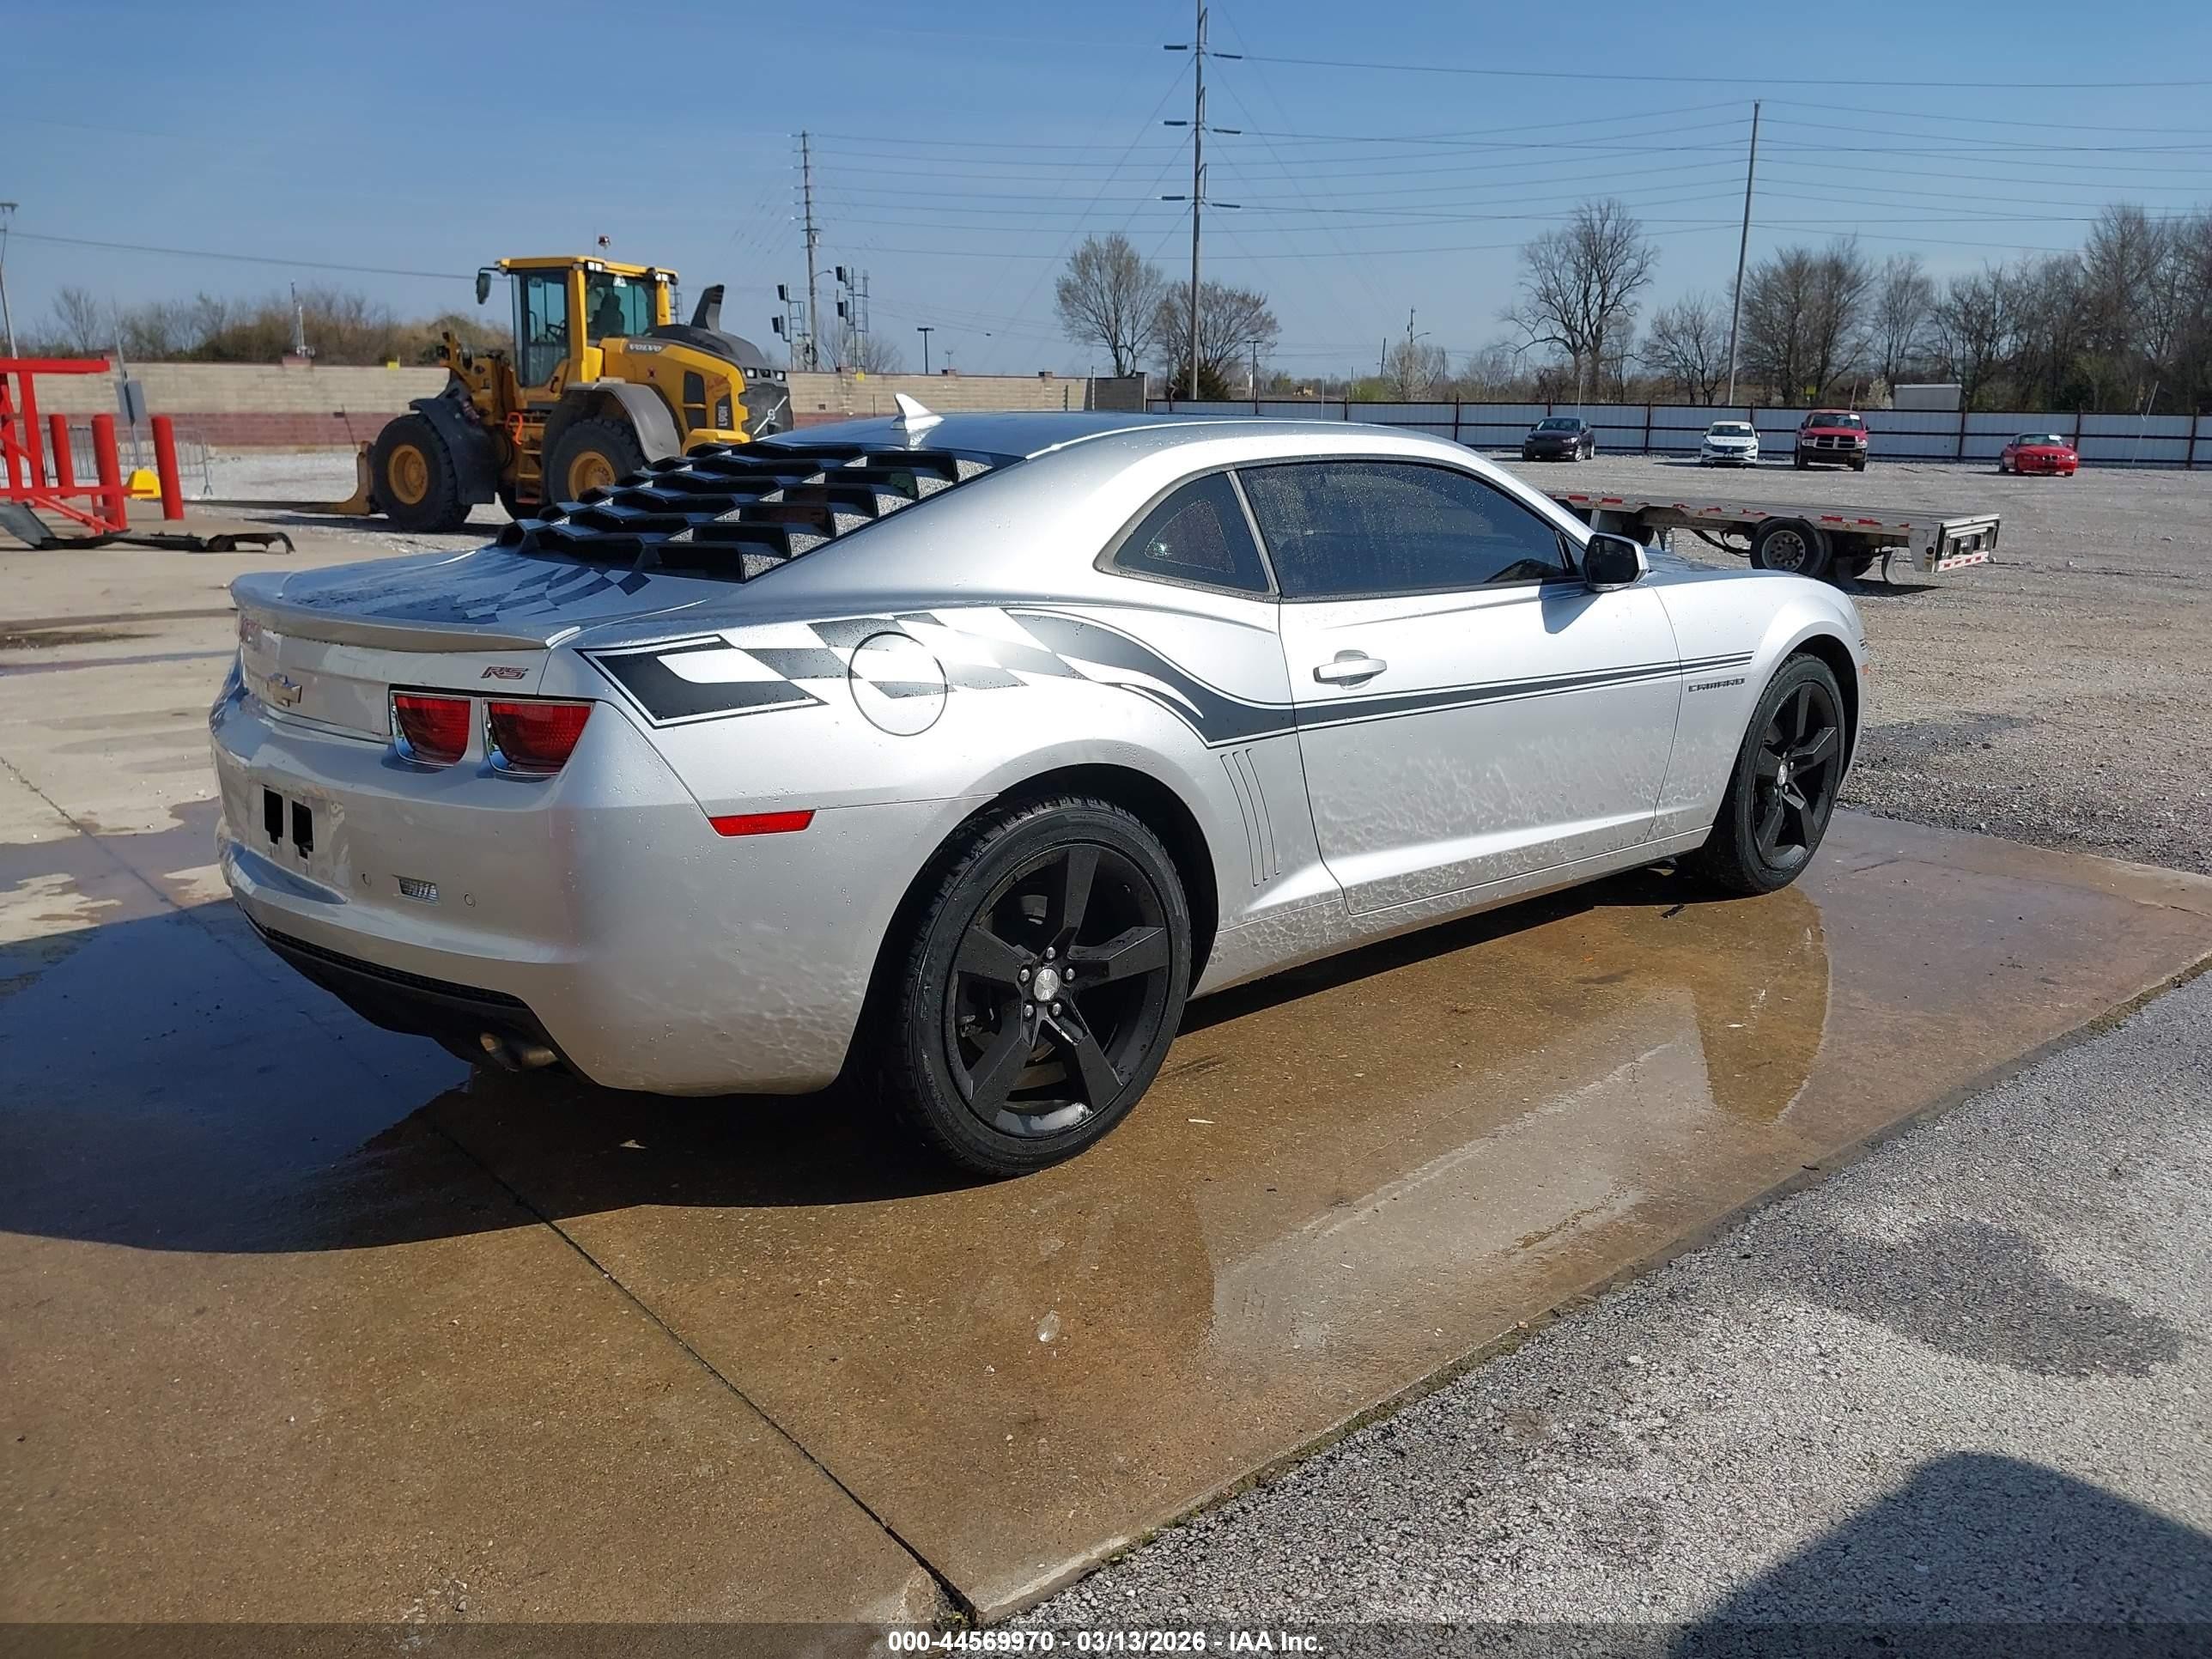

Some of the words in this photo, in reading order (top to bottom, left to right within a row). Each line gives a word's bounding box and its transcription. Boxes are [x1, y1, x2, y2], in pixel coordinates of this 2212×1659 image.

[629, 343, 662, 353] VOLVO
[480, 666, 529, 679] RS
[1688, 678, 1746, 692] CAMARO
